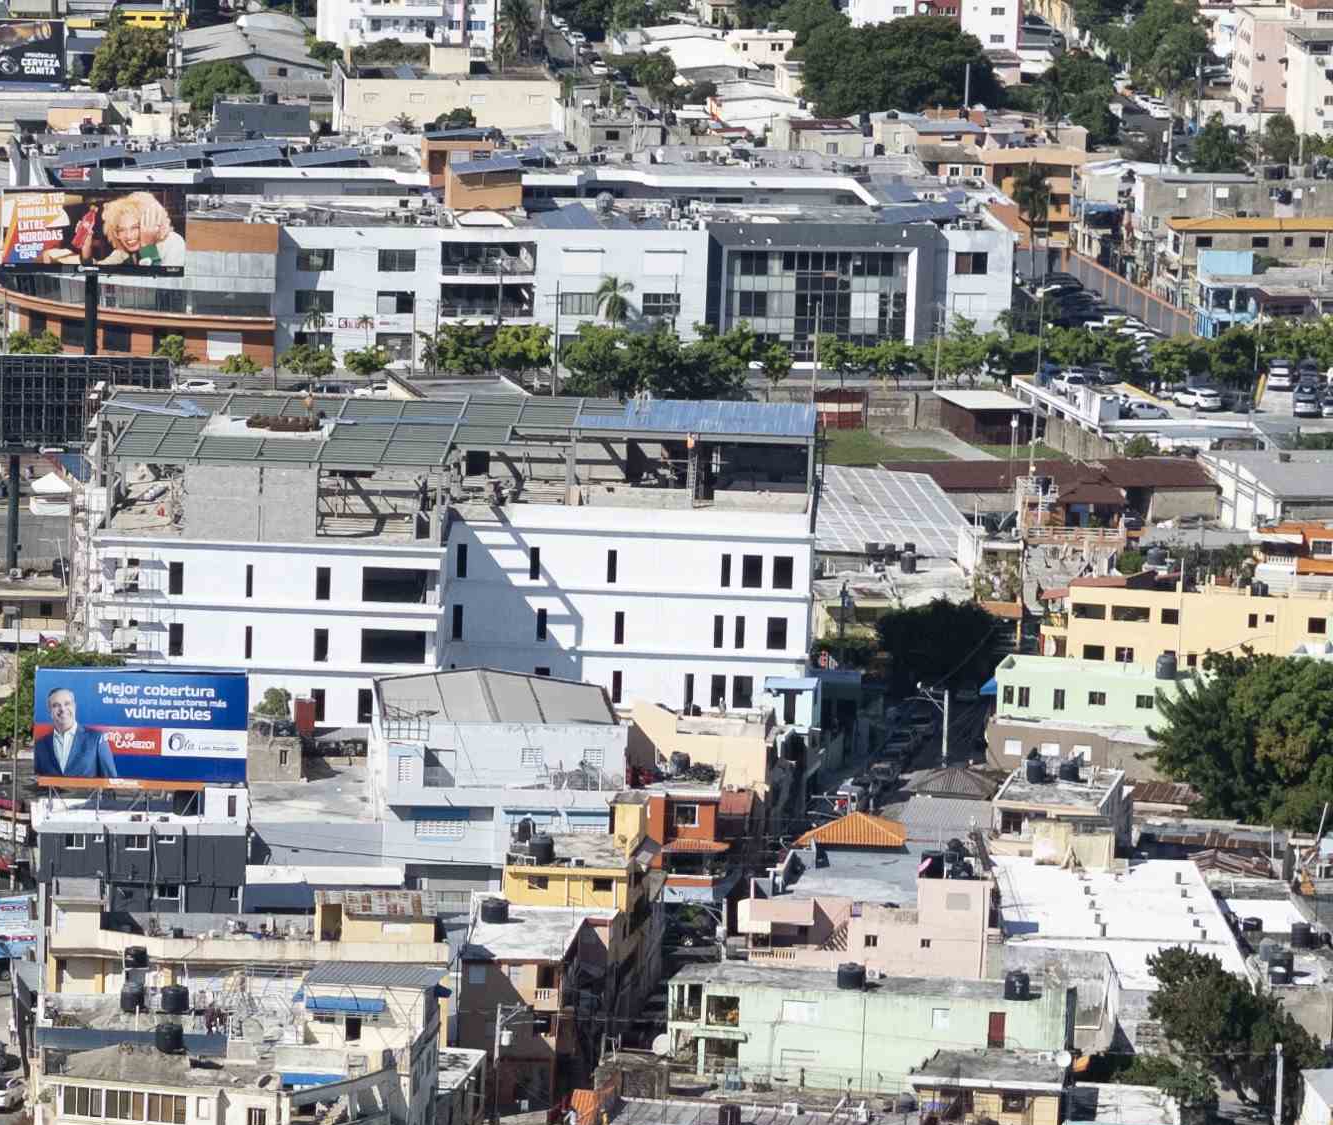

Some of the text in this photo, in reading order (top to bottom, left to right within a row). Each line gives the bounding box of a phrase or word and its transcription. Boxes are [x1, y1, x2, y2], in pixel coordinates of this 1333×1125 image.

[21, 58, 60, 67] CERVEZA
[98, 682, 215, 698] Mejor cobertura
[115, 697, 138, 705] salud
[139, 698, 158, 707] para
[172, 699, 208, 707] sectores
[209, 699, 227, 708] más
[124, 706, 212, 721] vulnerables
